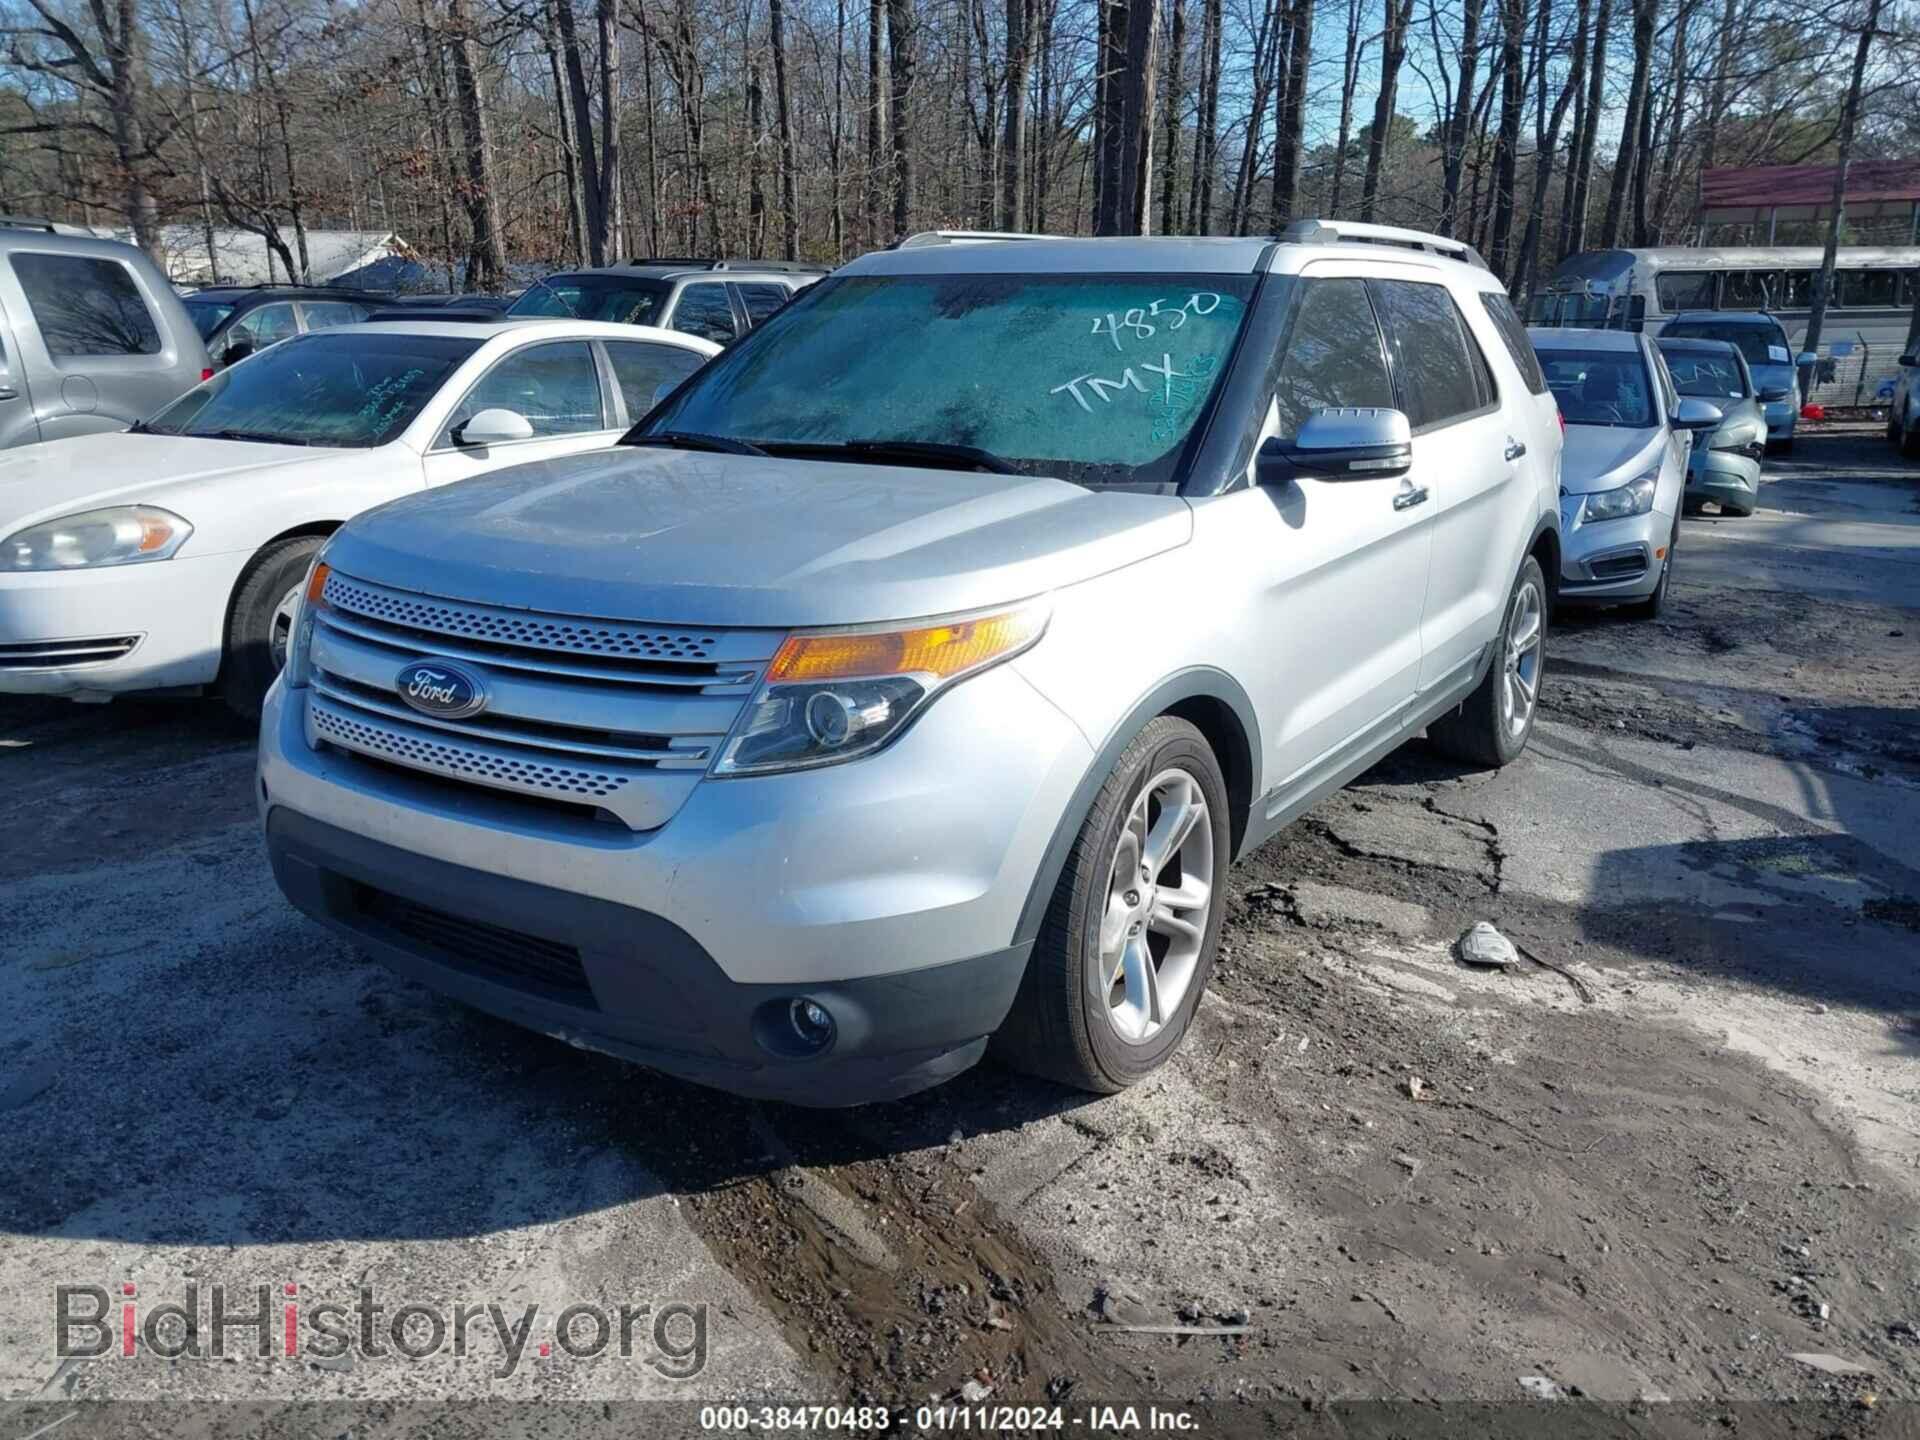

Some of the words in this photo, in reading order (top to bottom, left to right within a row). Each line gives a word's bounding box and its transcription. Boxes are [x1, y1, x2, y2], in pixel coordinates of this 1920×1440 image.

[1091, 292, 1221, 351] 4850
[1050, 353, 1190, 414] TMX
[408, 668, 458, 704] Ford
